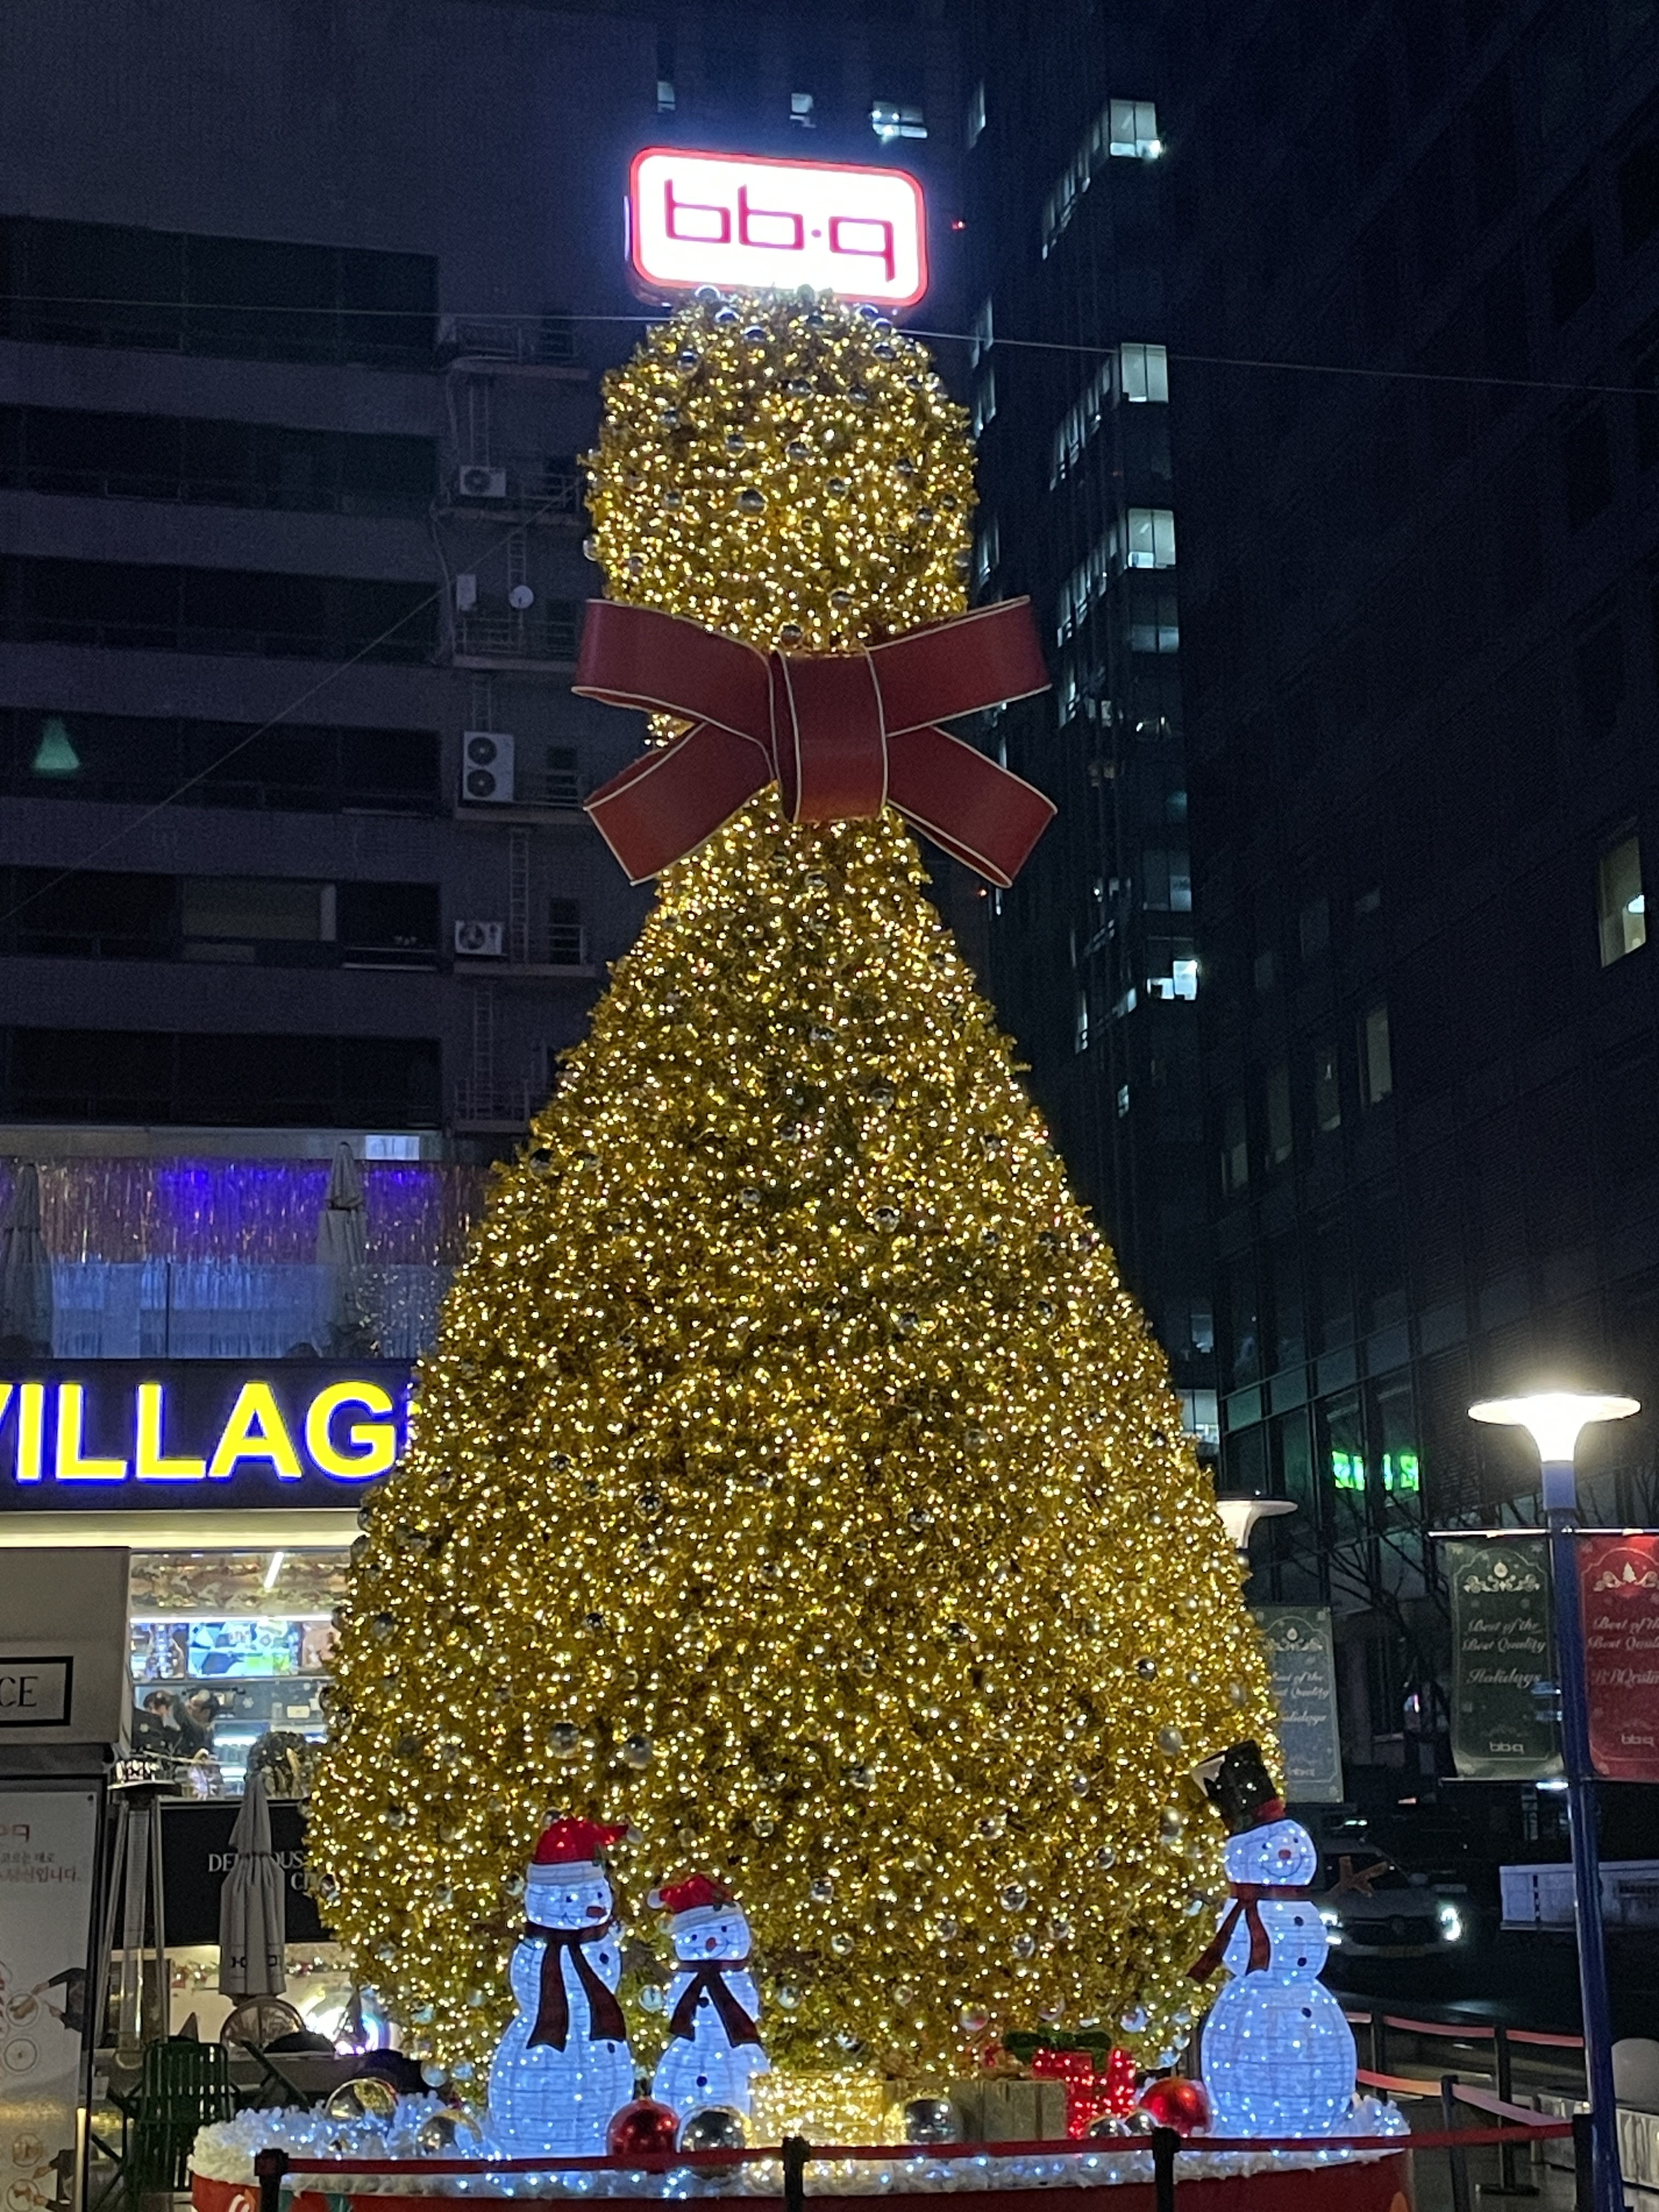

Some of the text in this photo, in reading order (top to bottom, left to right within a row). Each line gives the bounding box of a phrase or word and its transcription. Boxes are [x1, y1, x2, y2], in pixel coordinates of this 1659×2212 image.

[0, 1380, 420, 1481] ILLAG
[1466, 1618, 1502, 1634] Best
[1462, 1637, 1547, 1654] Best Quality
[1273, 1672, 1291, 1682] est
[1466, 1668, 1542, 1688] Holidays
